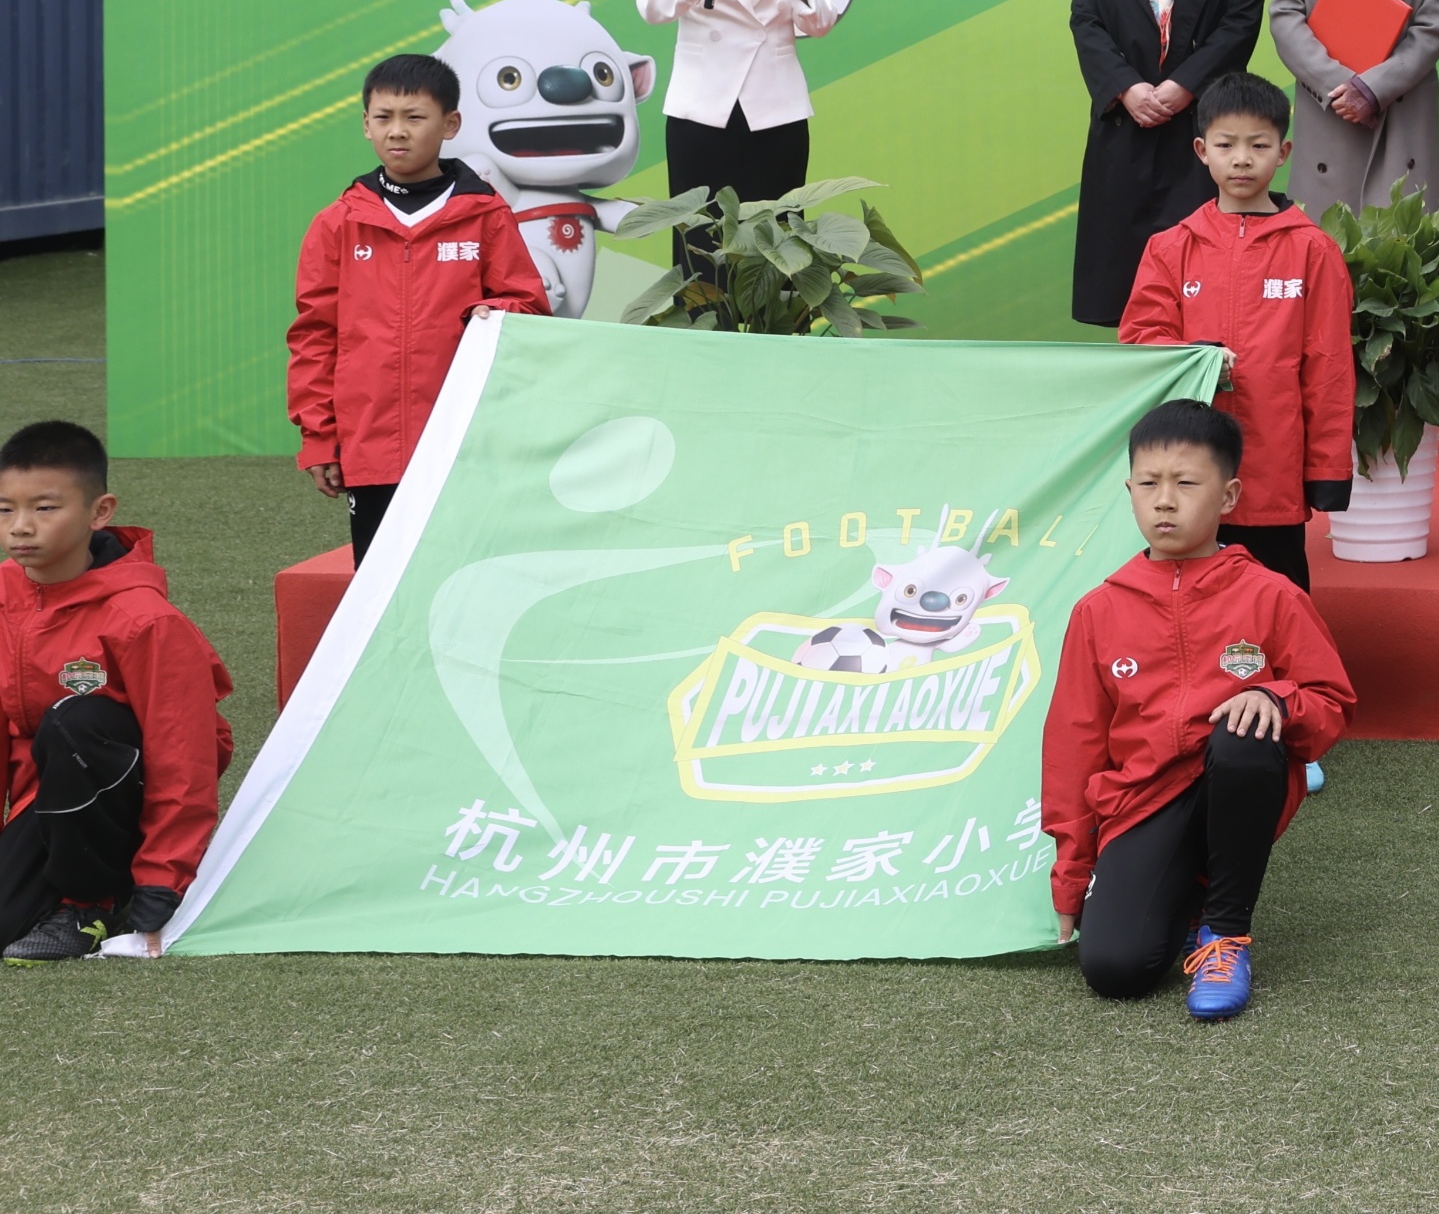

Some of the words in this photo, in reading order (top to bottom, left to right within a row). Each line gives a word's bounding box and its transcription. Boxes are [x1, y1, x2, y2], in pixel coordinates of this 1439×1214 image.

[437, 241, 480, 262] 濮家
[1262, 278, 1303, 299] 濮家
[443, 796, 1042, 887] 杭州市濮家小学
[419, 863, 748, 910] HANGZHOUSHI
